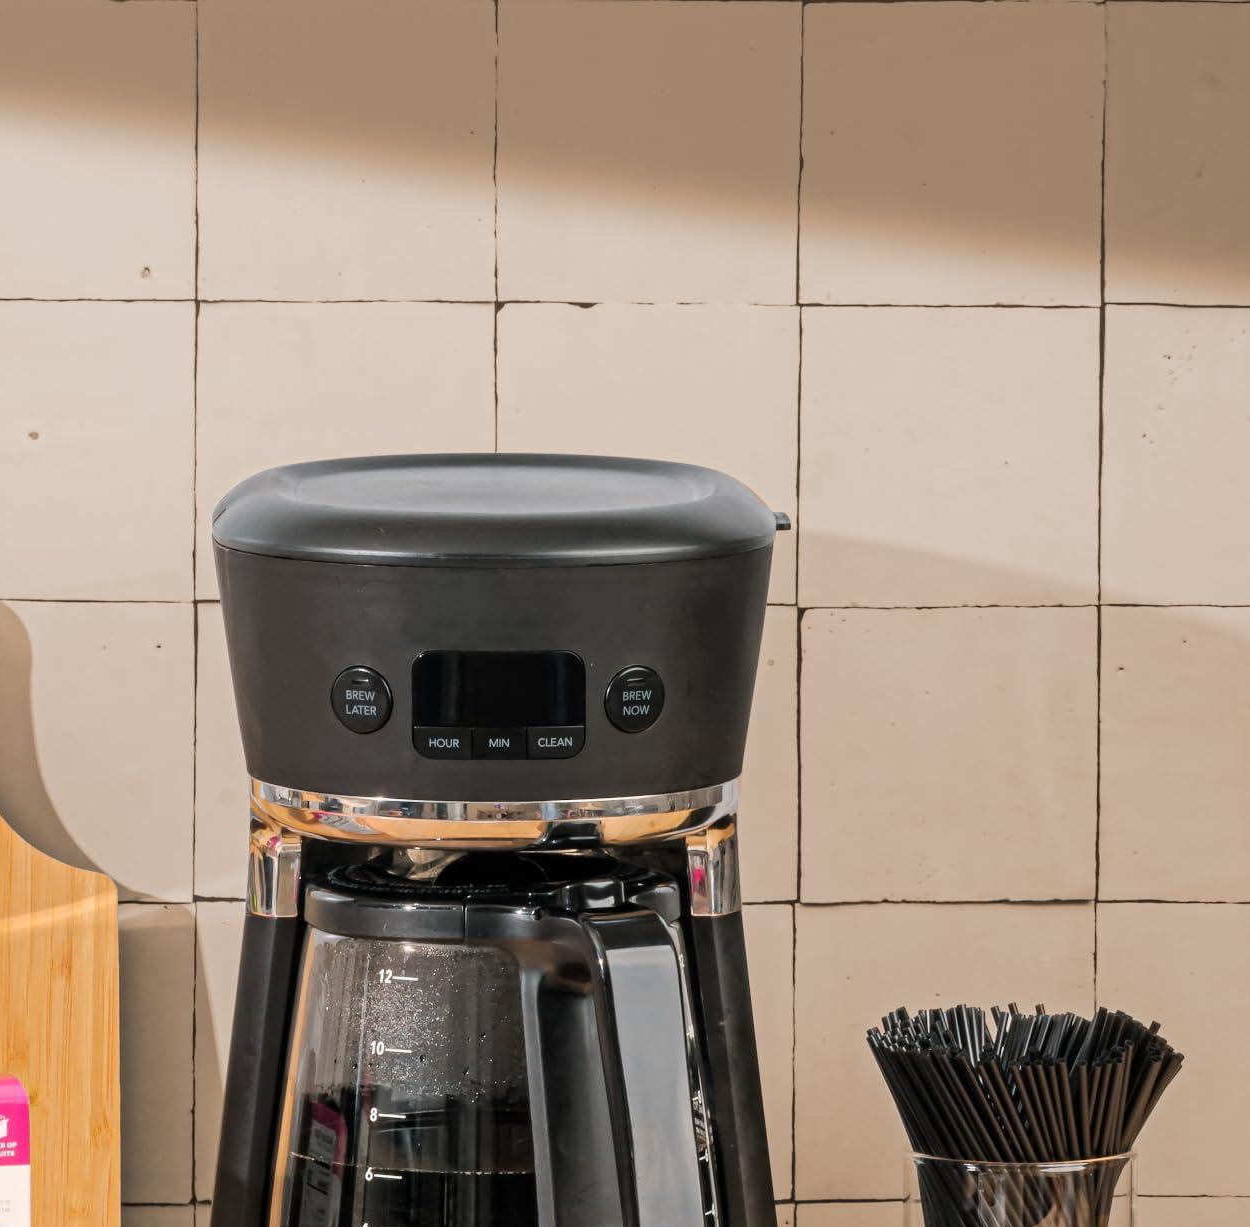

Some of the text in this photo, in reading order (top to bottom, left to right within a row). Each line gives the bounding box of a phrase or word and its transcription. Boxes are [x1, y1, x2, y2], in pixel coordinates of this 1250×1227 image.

[345, 689, 375, 701] BREW
[622, 689, 652, 701] BREW
[345, 704, 377, 716] LATER
[622, 704, 650, 716] NOW
[428, 737, 460, 748] HOUR
[488, 737, 510, 748] MIN
[537, 737, 573, 748] CLEAN
[378, 969, 393, 984] 12
[370, 1040, 385, 1055] 10
[369, 1107, 378, 1122] 8
[364, 1167, 374, 1182] 6
